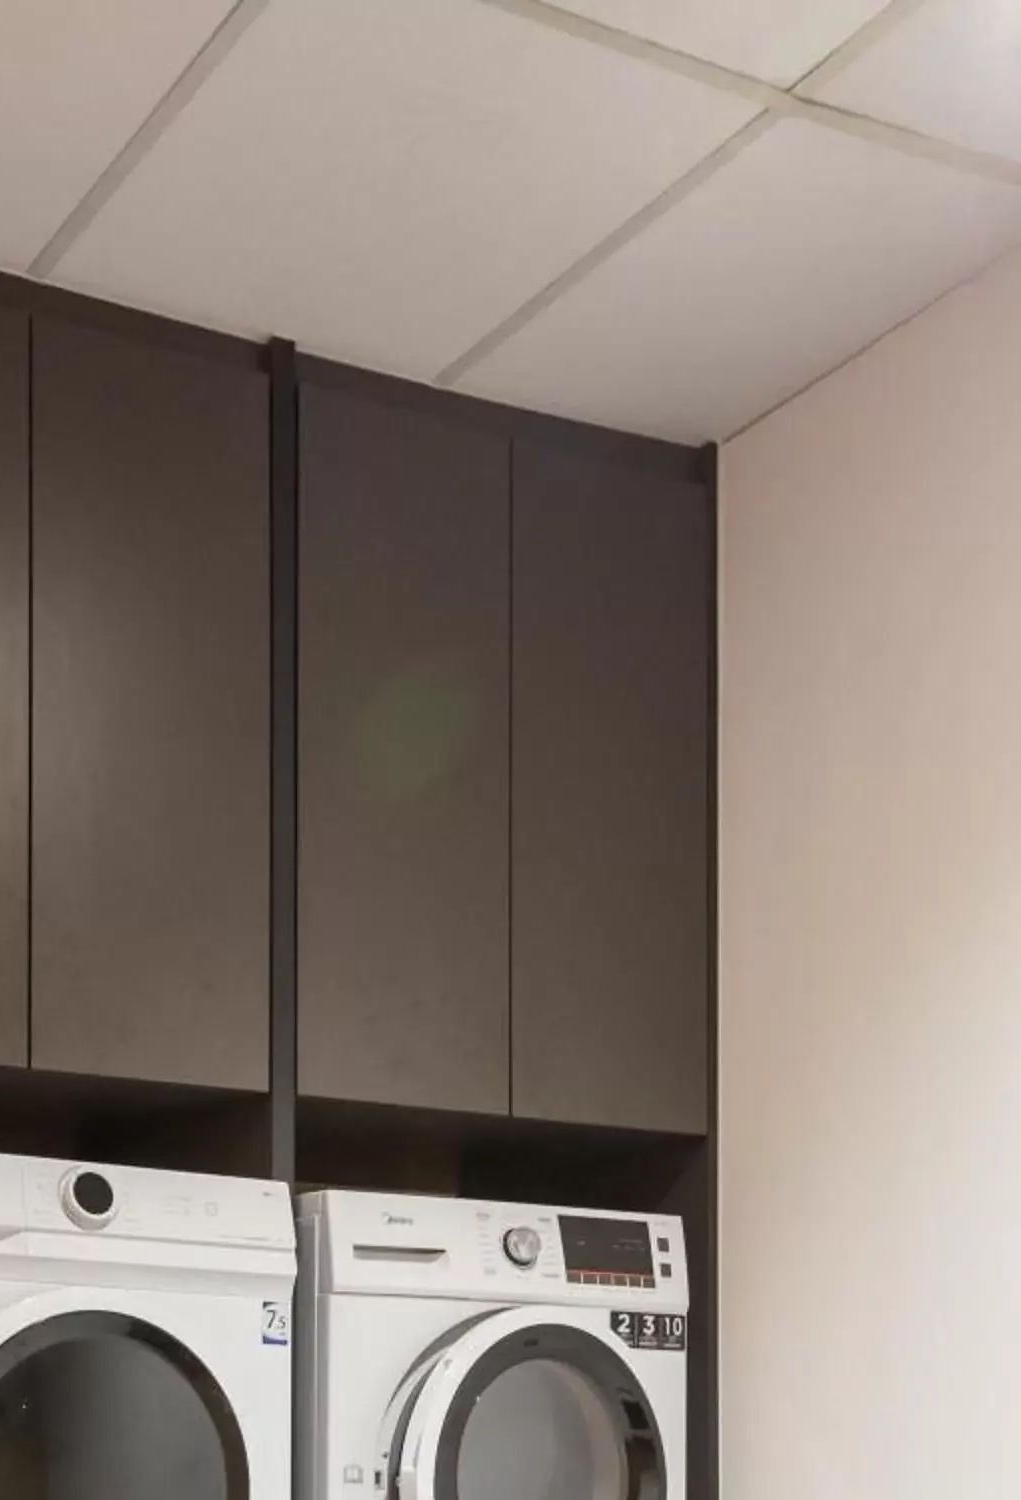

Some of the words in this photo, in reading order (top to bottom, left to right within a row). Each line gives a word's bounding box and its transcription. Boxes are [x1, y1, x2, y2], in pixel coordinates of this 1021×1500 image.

[617, 1313, 631, 1333] 2
[642, 1315, 655, 1336] 3
[665, 1317, 683, 1336] 10
